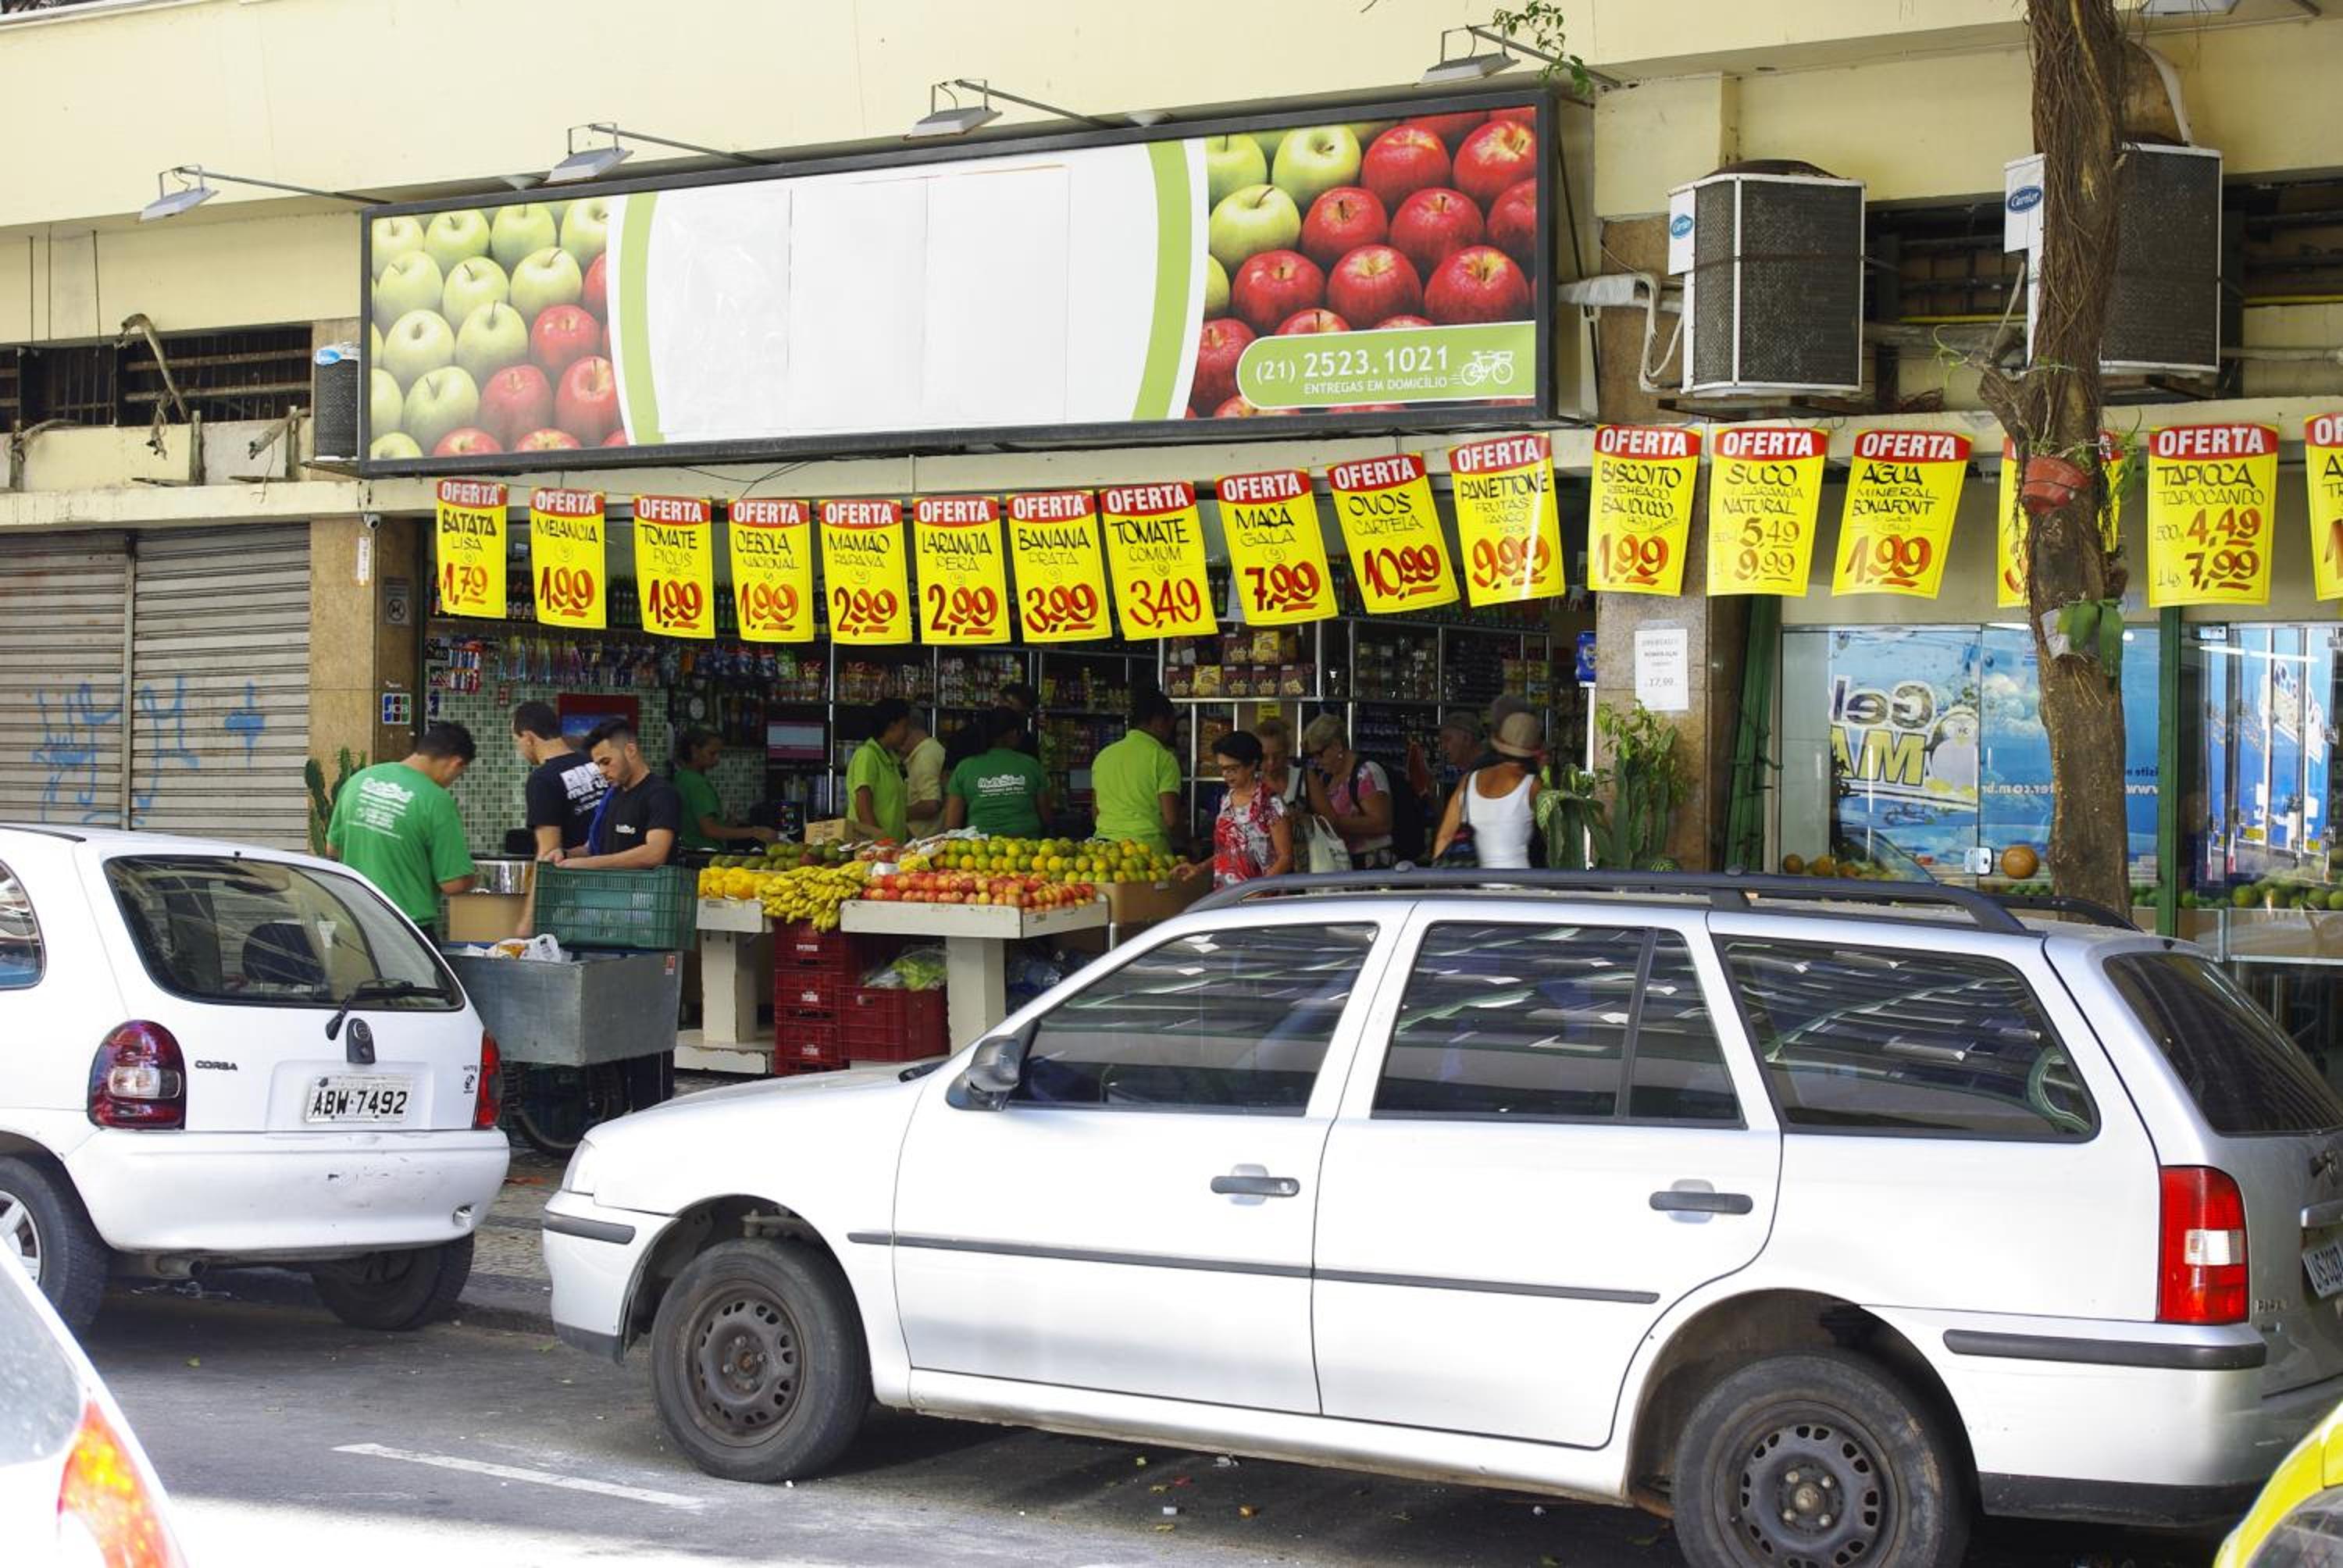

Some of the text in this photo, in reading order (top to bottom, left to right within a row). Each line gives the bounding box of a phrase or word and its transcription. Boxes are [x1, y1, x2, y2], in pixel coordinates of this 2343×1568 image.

[1255, 345, 1448, 384] (21) 2523.1021
[1303, 382, 1364, 395] ENTREGAS
[1367, 381, 1385, 391] EM
[1602, 429, 1687, 456] OFERTA
[1724, 432, 1813, 456] OFERTA
[1862, 434, 1956, 458] OFERTA
[2158, 428, 2264, 456] OFERTA
[1457, 438, 1540, 472] OFERTA
[1335, 458, 1417, 490] OFERTA
[1601, 460, 1681, 488] BISCOITO
[1725, 463, 1797, 486] SUCO
[2156, 462, 2256, 487] TAPIOCA
[441, 481, 498, 505] OFERTA
[1107, 485, 1188, 512] OFERTA
[1223, 473, 1302, 501] OFERTA
[535, 491, 596, 514] OFERTA
[640, 498, 702, 522] OFERTA
[734, 502, 800, 523] OFERTA
[826, 503, 893, 524] OFERTA
[920, 501, 990, 522] OFERTA
[1014, 494, 1086, 519] OFERTA
[1349, 493, 1412, 516] OVOS
[1723, 497, 1797, 515] NATURAL
[443, 510, 497, 536] BATATA
[537, 518, 597, 543] MELANCIA
[1111, 519, 1189, 545] TOMATE
[1739, 517, 1800, 548] 5,49
[2187, 508, 2262, 547] 4,49
[640, 525, 697, 549] TOMATE
[736, 530, 792, 555] CEBOLA
[922, 531, 992, 555] LARANJA
[1018, 526, 1090, 551] BANANA
[1240, 529, 1296, 547] GALA
[2184, 549, 2259, 591] 7,99
[1129, 578, 1200, 629] 3,49
[194, 1060, 238, 1071] CORSA
